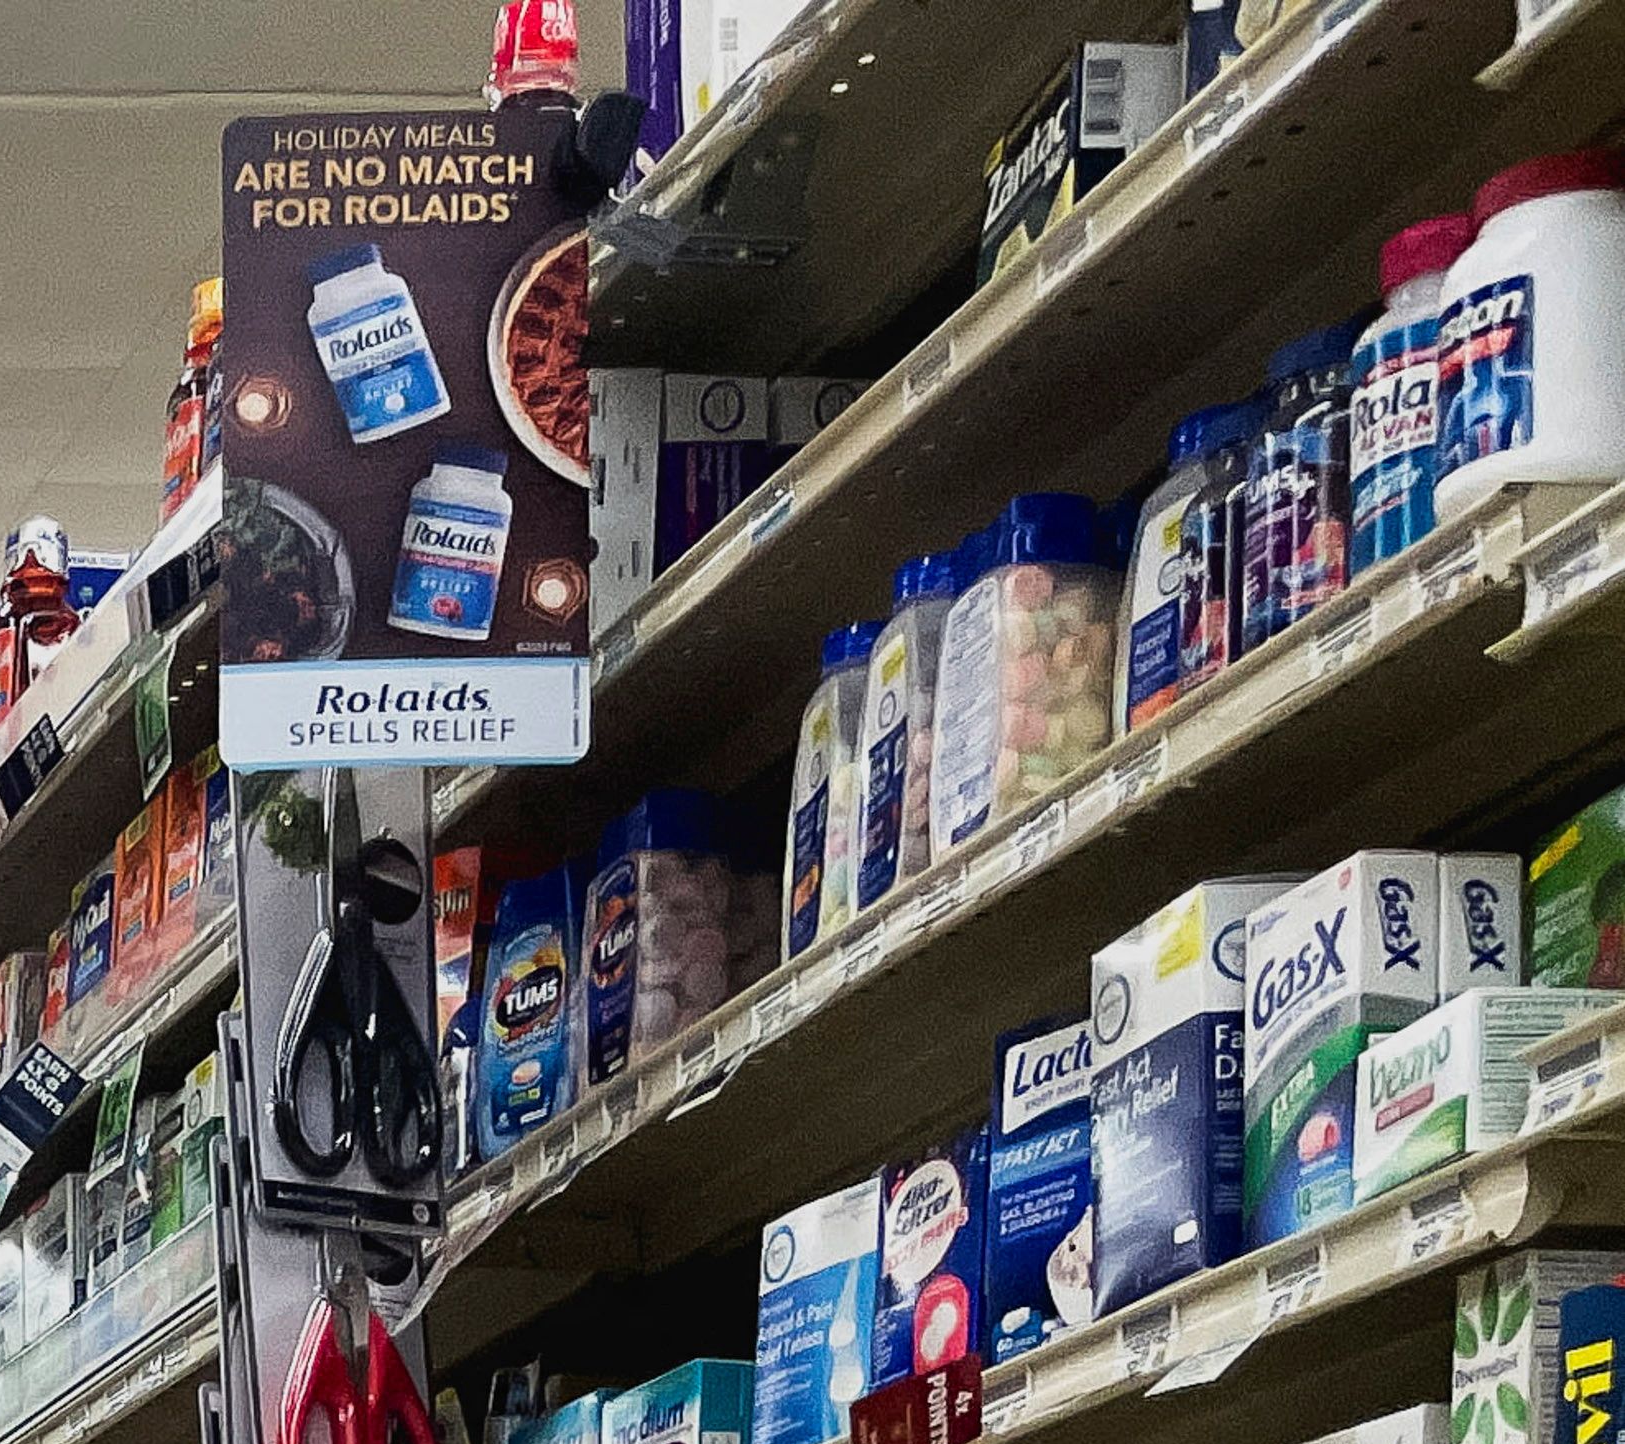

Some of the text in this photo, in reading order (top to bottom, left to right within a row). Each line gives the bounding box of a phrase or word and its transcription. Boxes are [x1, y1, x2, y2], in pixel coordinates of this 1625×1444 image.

[273, 124, 495, 152] HOLIDAY MEALS
[234, 153, 534, 193] ARE NO MATCH
[984, 97, 1070, 233] Zantac
[253, 192, 511, 228] FOR ROLAIDS
[329, 315, 414, 364] Rolaids
[411, 519, 496, 555] Rolaids
[315, 681, 492, 715] Rolaids
[288, 719, 516, 745] SPELLS RELIEF
[1377, 878, 1423, 972] Gas-X
[1463, 879, 1507, 973] Gas-X
[1251, 908, 1348, 1032] Gas-X
[505, 975, 559, 1014] TUMS
[1369, 1026, 1451, 1109] beano
